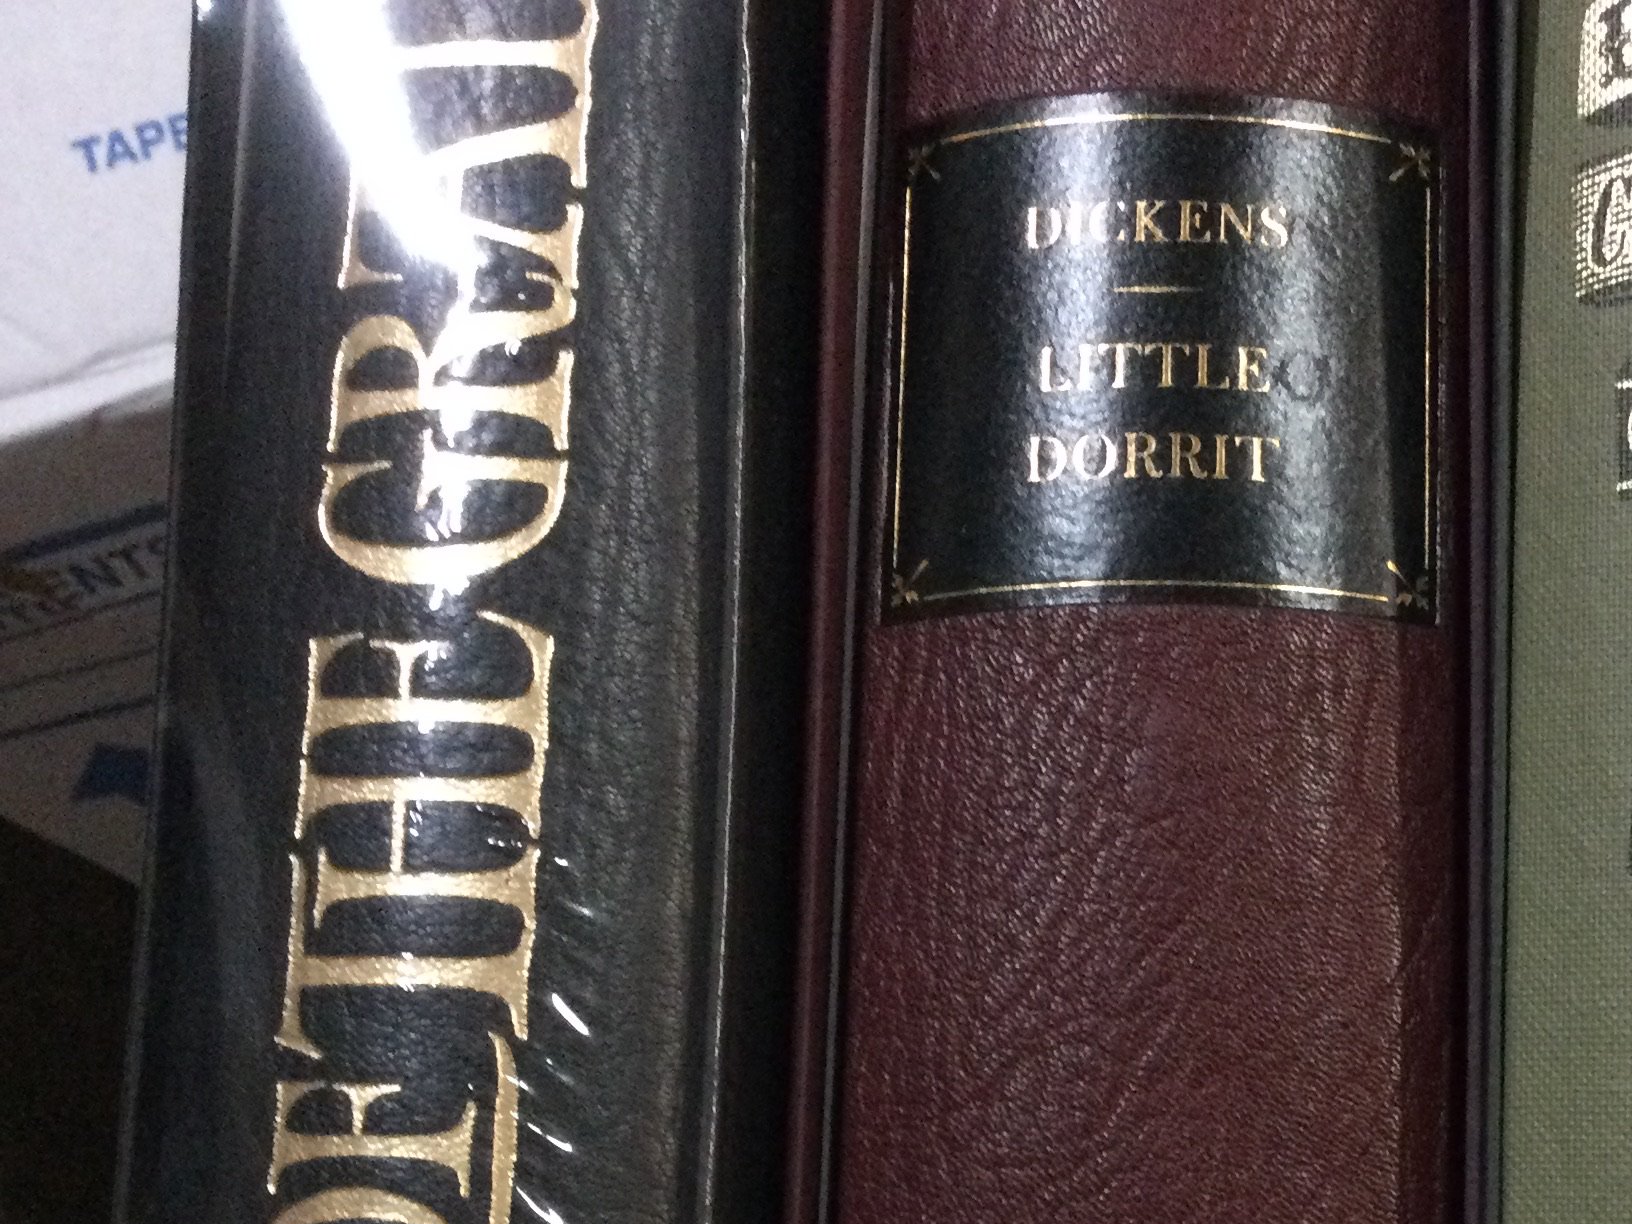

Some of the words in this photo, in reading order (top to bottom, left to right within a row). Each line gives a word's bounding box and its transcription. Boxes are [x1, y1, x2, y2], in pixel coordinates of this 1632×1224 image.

[1025, 199, 1289, 251] DICKENS
[1037, 341, 1273, 394] LITTLE
[1026, 431, 1282, 484] DORRIT
[275, 609, 556, 1059] THE
